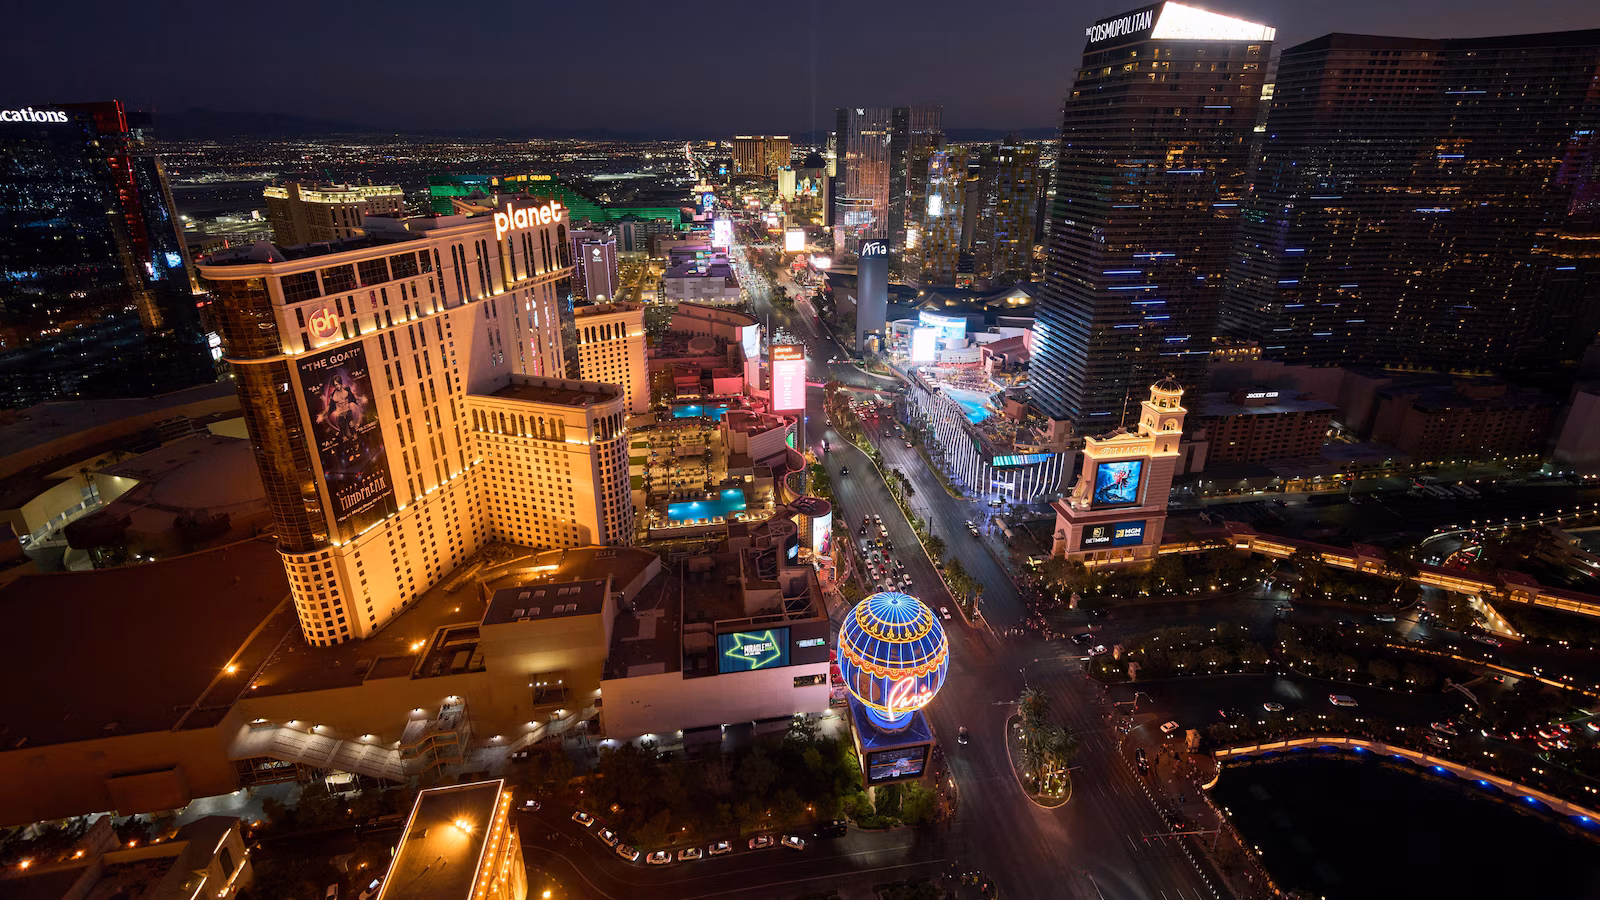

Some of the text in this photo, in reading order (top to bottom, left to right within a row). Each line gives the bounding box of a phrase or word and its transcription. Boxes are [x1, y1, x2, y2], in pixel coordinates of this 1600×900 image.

[1091, 10, 1153, 43] COSMOPOLITAN
[0, 107, 68, 122] cations
[694, 184, 714, 192] MGM
[494, 200, 562, 241] planet
[862, 242, 887, 256] Aria
[312, 308, 339, 336] ph
[774, 353, 801, 361] hollywood
[1124, 527, 1142, 535] MGM
[743, 643, 766, 653] MIRACLE
[888, 676, 933, 722] Paris
